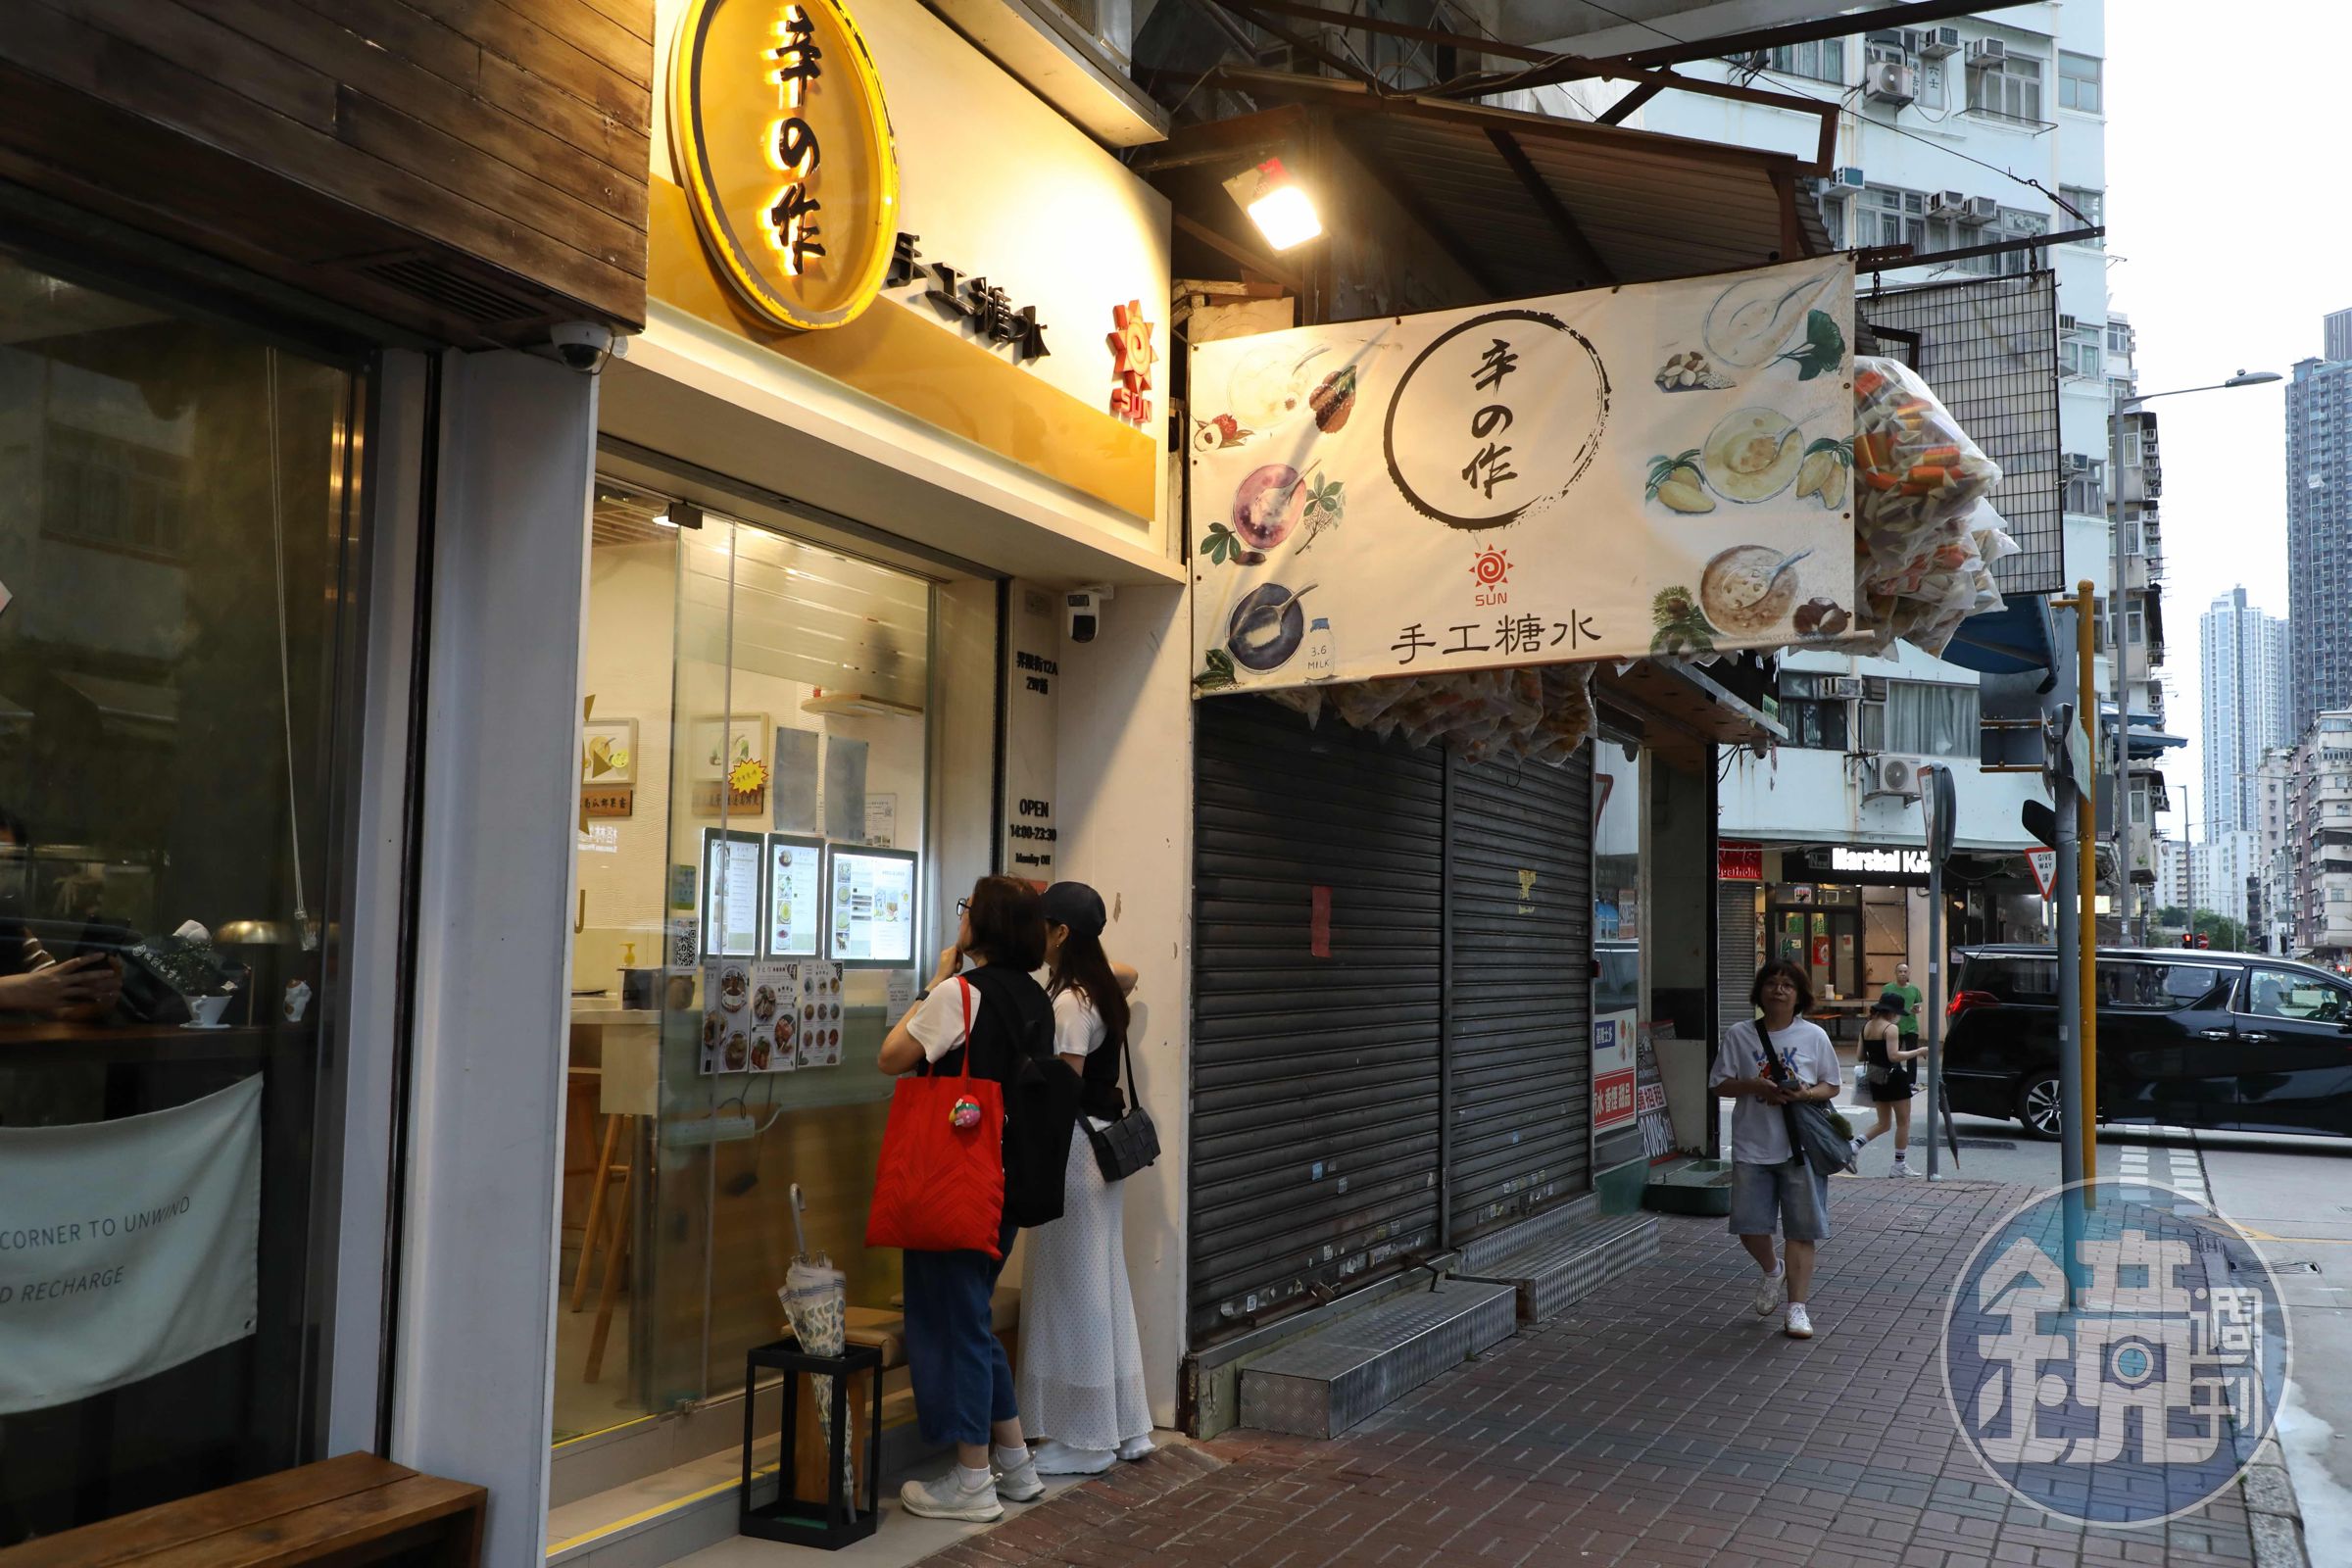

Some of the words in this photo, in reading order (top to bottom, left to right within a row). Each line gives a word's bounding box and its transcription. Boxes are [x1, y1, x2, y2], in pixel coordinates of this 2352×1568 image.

[886, 231, 1052, 360] 手工糖水
[1112, 387, 1152, 422] SUN
[1474, 590, 1508, 607] SUN
[1391, 608, 1602, 665] 手工糖水
[1310, 644, 1327, 658] 3.6
[1307, 658, 1331, 670] MILK
[1019, 798, 1050, 818] OPEN
[1009, 823, 1057, 841] 14:00-23:30
[1041, 855, 1052, 865] Off
[2037, 853, 2053, 861] GIVE
[0, 1224, 80, 1250] CORNER
[88, 1218, 116, 1239] TO
[124, 1196, 190, 1233] UNWIND
[22, 1265, 125, 1302] RECHARGE
